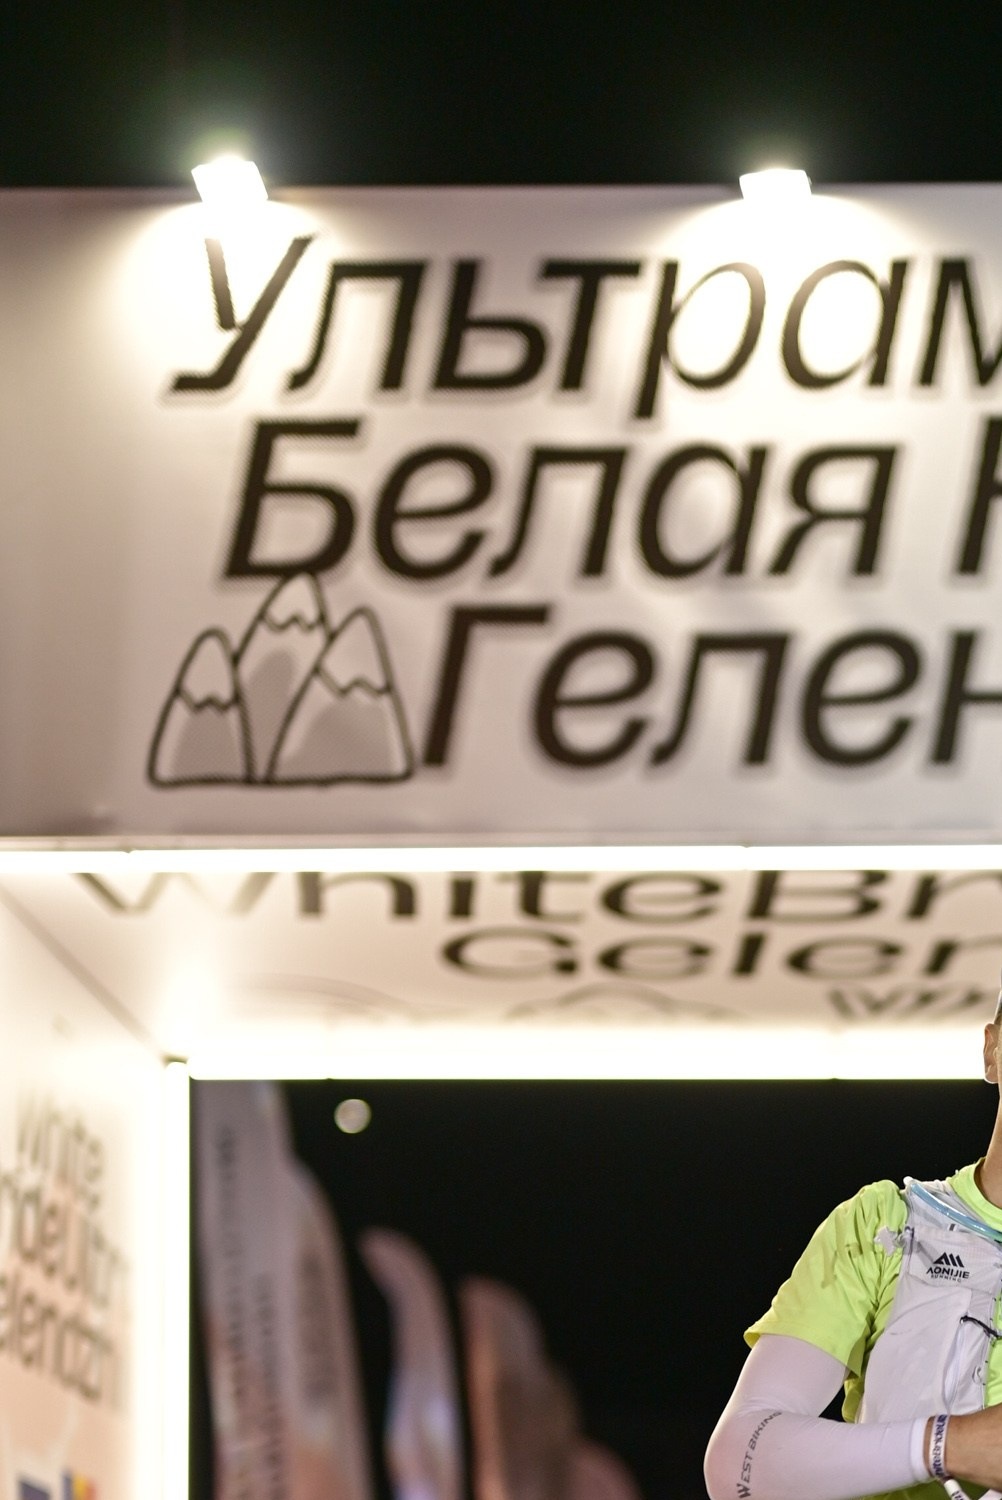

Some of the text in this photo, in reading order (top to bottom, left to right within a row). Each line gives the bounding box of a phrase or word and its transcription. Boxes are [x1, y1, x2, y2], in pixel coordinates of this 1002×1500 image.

[222, 418, 898, 580] Белая
[926, 1266, 970, 1279] AONIJIE
[736, 1451, 753, 1499] WEST
